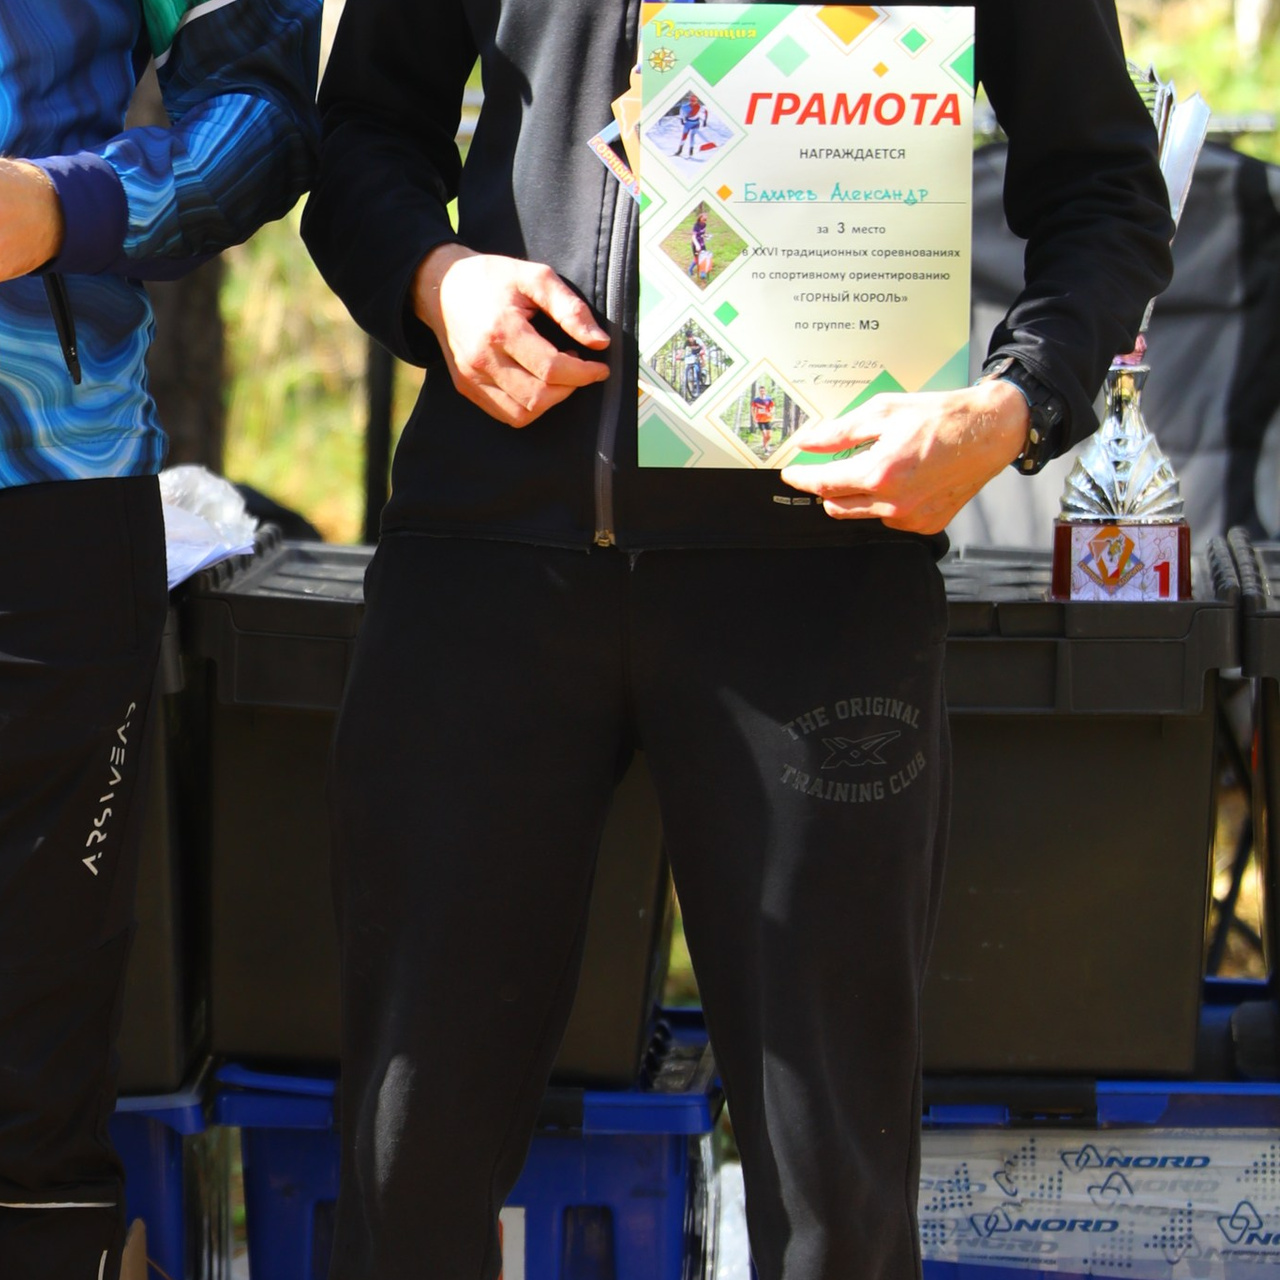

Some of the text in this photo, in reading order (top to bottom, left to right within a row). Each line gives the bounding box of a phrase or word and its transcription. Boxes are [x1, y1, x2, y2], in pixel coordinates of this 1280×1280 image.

[744, 92, 962, 126] ГРАМОТА
[799, 148, 907, 161] НАГРАЖДАЕТСЯ
[816, 222, 886, 234] за 3 место
[752, 247, 779, 257] XXVI
[781, 248, 868, 260] традиционных
[871, 248, 961, 260] соревнованиях
[751, 271, 950, 284] по спортивному ориентированию
[793, 290, 908, 303] «ГОРНЫЙ КОРОЛЬ»
[794, 320, 880, 331] по группе: МЭ
[1153, 561, 1170, 598] 1
[780, 697, 920, 741] THE ORIGINAL
[780, 751, 926, 803] TRAINING CLUB
[1104, 1155, 1211, 1169] NORD
[1013, 1219, 1120, 1233] NORD
